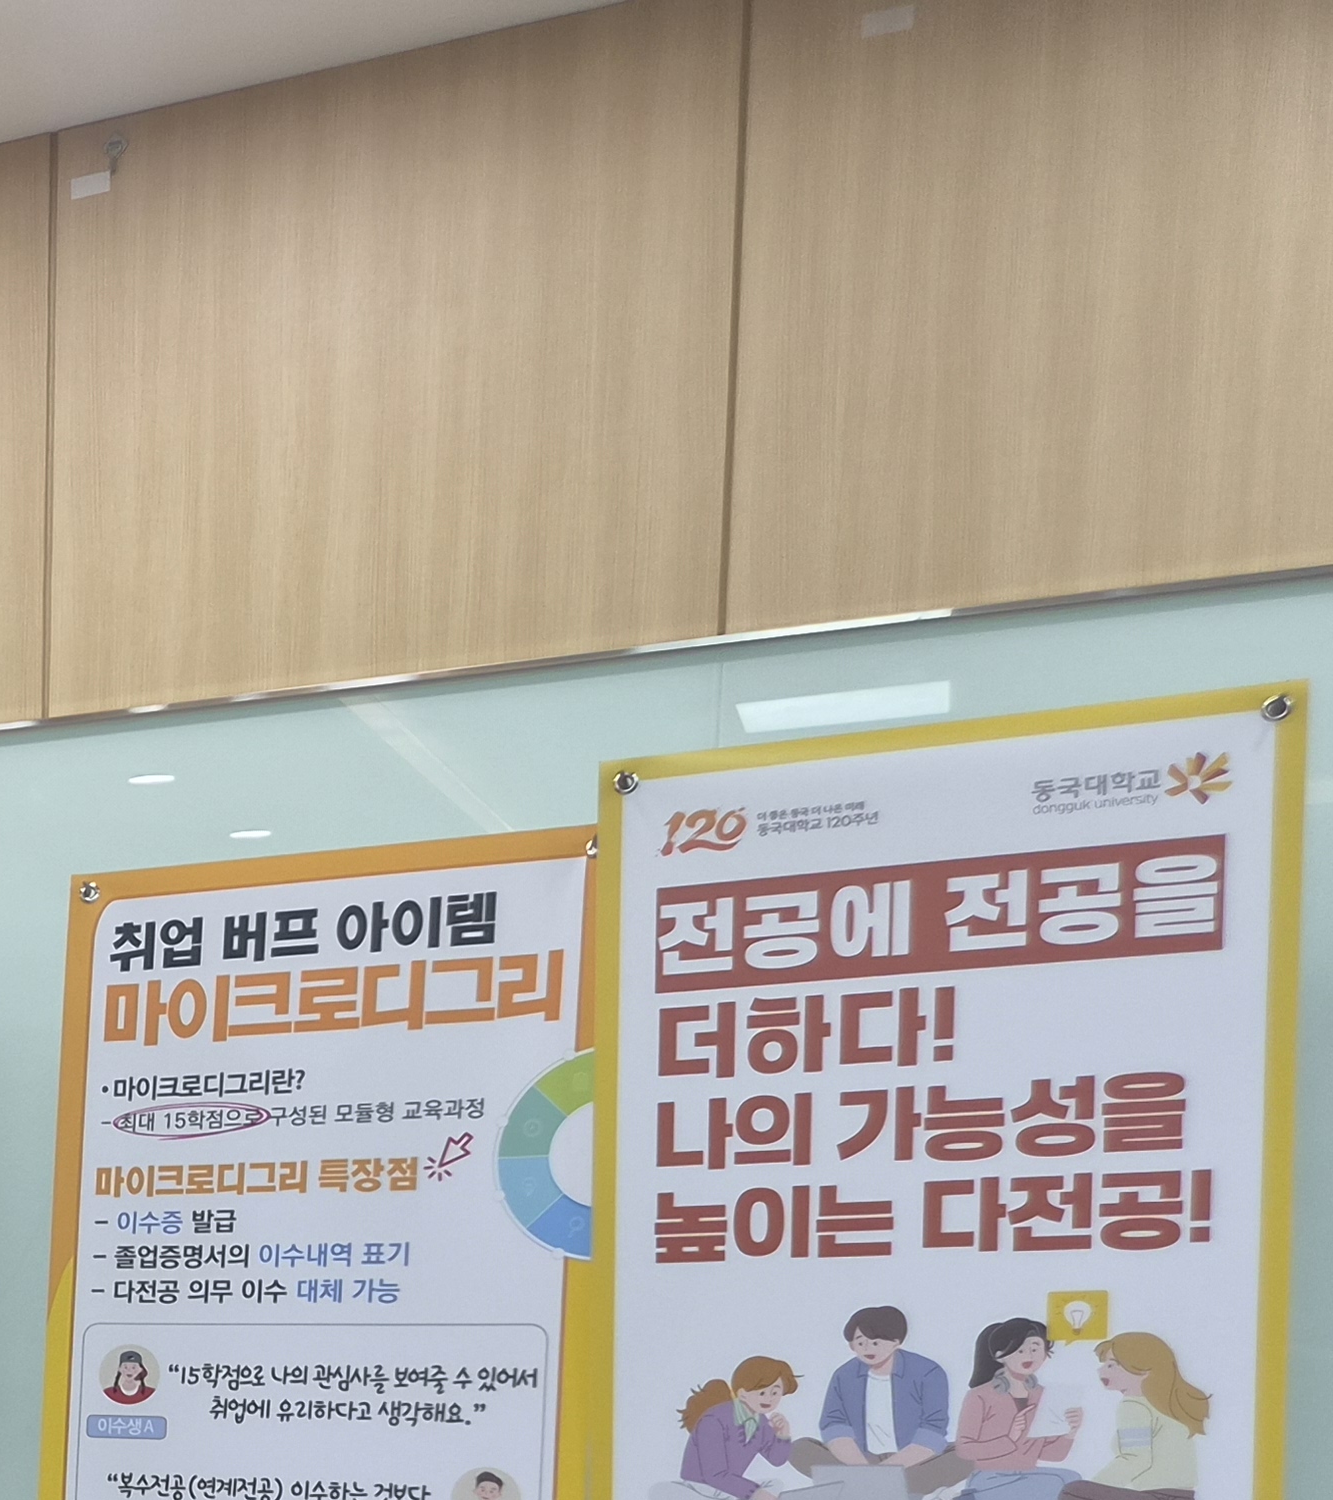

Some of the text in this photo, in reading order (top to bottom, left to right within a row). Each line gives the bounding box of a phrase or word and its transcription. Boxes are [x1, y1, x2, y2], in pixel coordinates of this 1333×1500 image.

[1031, 769, 1161, 803] 동국대학교
[1093, 790, 1161, 813] university
[757, 810, 879, 837] 동국대학교 120주년
[109, 891, 498, 973] 취업 버프 아이템
[657, 854, 1219, 976] 전공에 전공을
[103, 948, 565, 1047] 마이크로디그리
[658, 986, 956, 1079] 더하다!
[113, 1068, 306, 1102] 마이크로디그리란?
[119, 1097, 485, 1135] 최대 15학점으로 구성된 모듈형 교육과정
[656, 1071, 1187, 1170] 나의 가능성을
[95, 1156, 418, 1199] 마이크로디그리 특장점
[117, 1209, 237, 1235] 이수증 발급
[654, 1168, 1213, 1264] 높이는 다전공!
[114, 1241, 410, 1270] 졸업증명서의 이수내역 표기
[113, 1278, 401, 1304] 다전공 의무 이수 대체 가능
[271, 1365, 309, 1385] 나의
[312, 1364, 390, 1395] 관심사를
[393, 1364, 449, 1395] 보여줄
[452, 1367, 473, 1390] 수
[477, 1366, 538, 1392] 있어서
[209, 1395, 271, 1424] 취업에
[276, 1399, 372, 1423] 유리하다고
